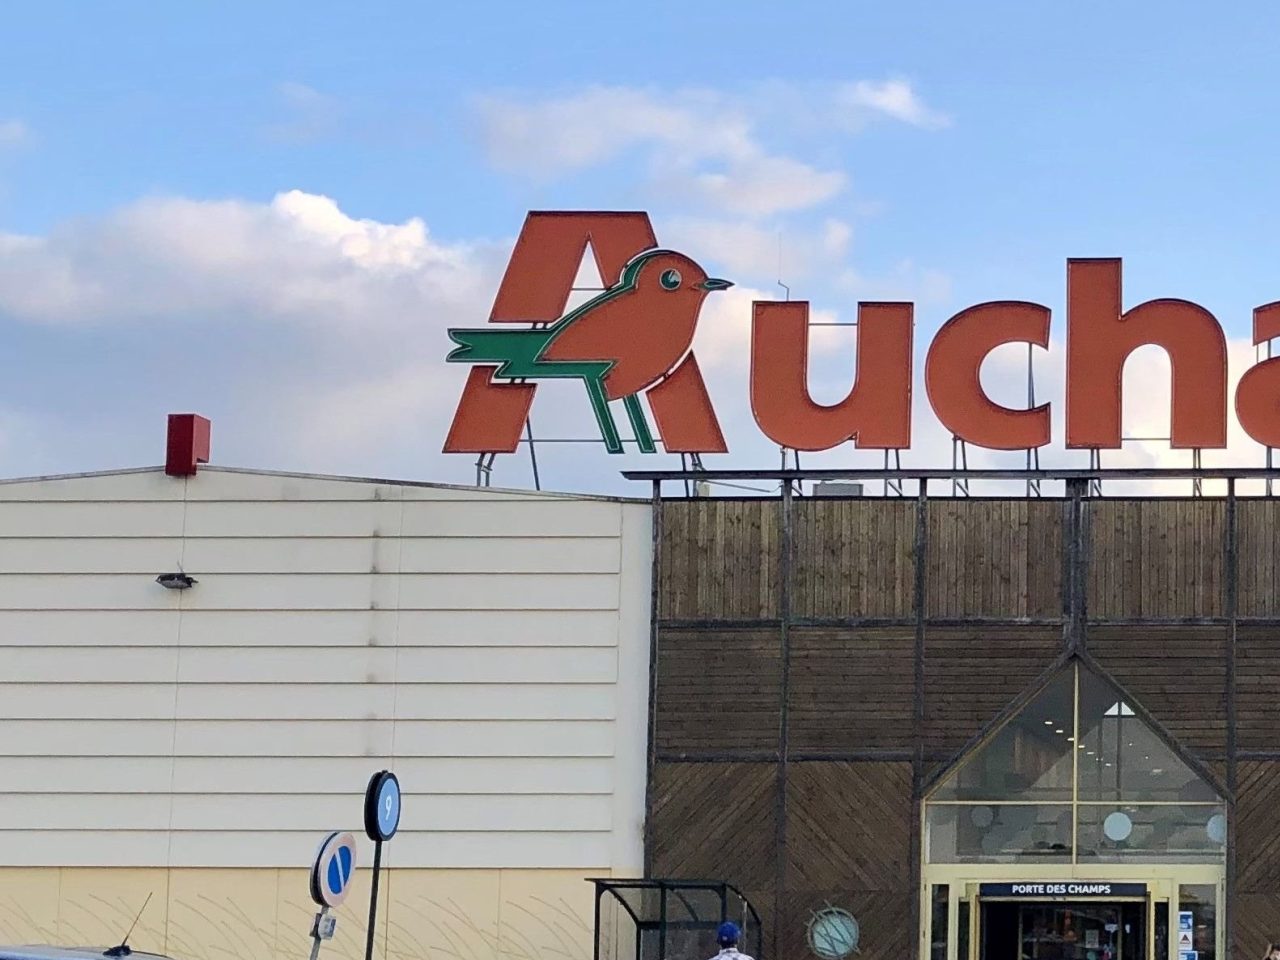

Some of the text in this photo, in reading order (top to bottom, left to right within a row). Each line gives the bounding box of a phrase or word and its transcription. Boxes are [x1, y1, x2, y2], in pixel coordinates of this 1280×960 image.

[1012, 884, 1111, 894] PORTE DES CHAMPS
